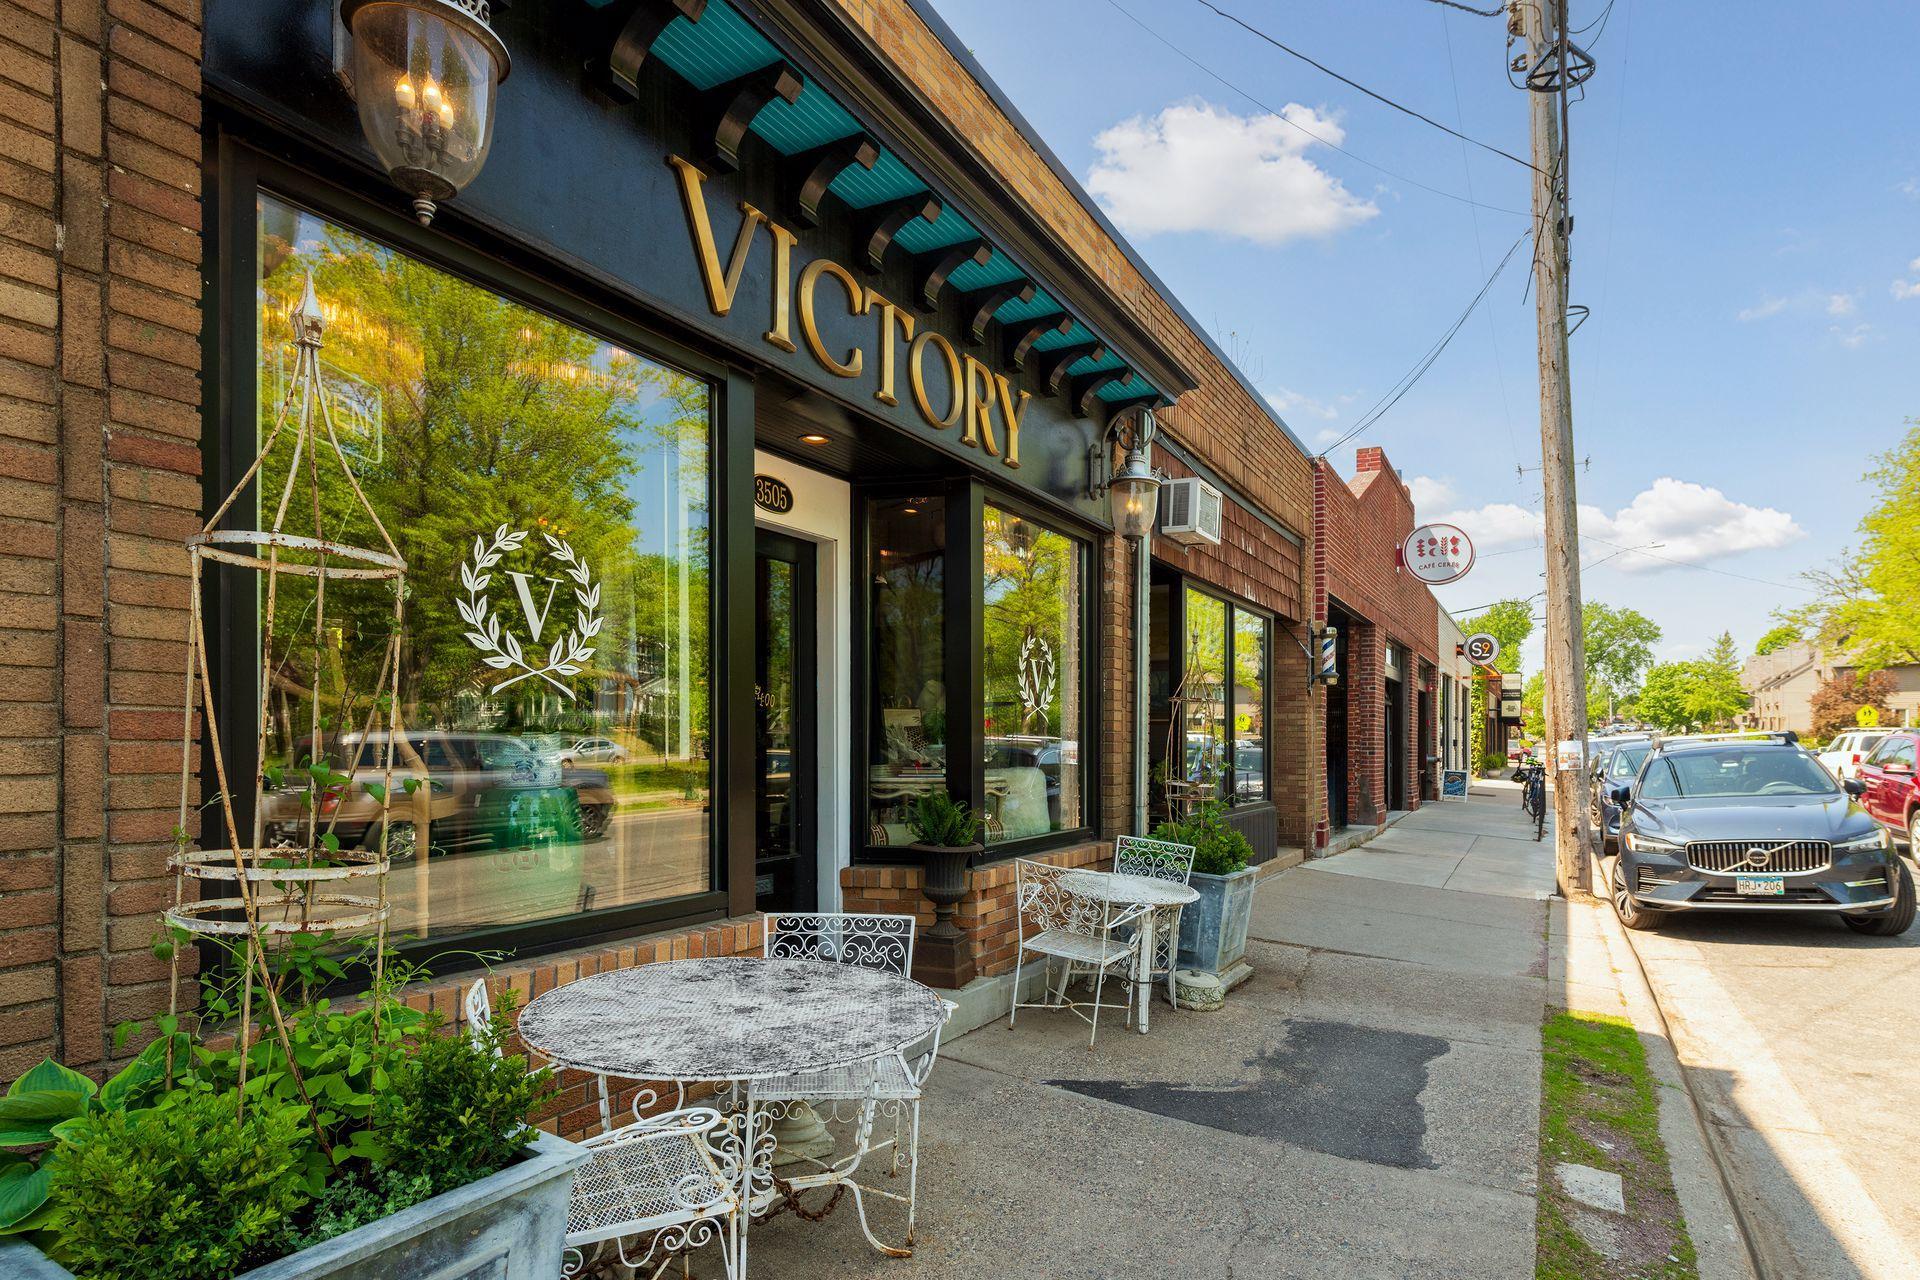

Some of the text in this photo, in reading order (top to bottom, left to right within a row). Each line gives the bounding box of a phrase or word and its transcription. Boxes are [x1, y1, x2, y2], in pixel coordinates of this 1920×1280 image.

[668, 154, 1032, 469] VICTORY
[756, 479, 787, 509] 3505
[504, 570, 564, 643] V
[1029, 658, 1045, 694] V
[1738, 880, 1781, 890] HRJ 206
